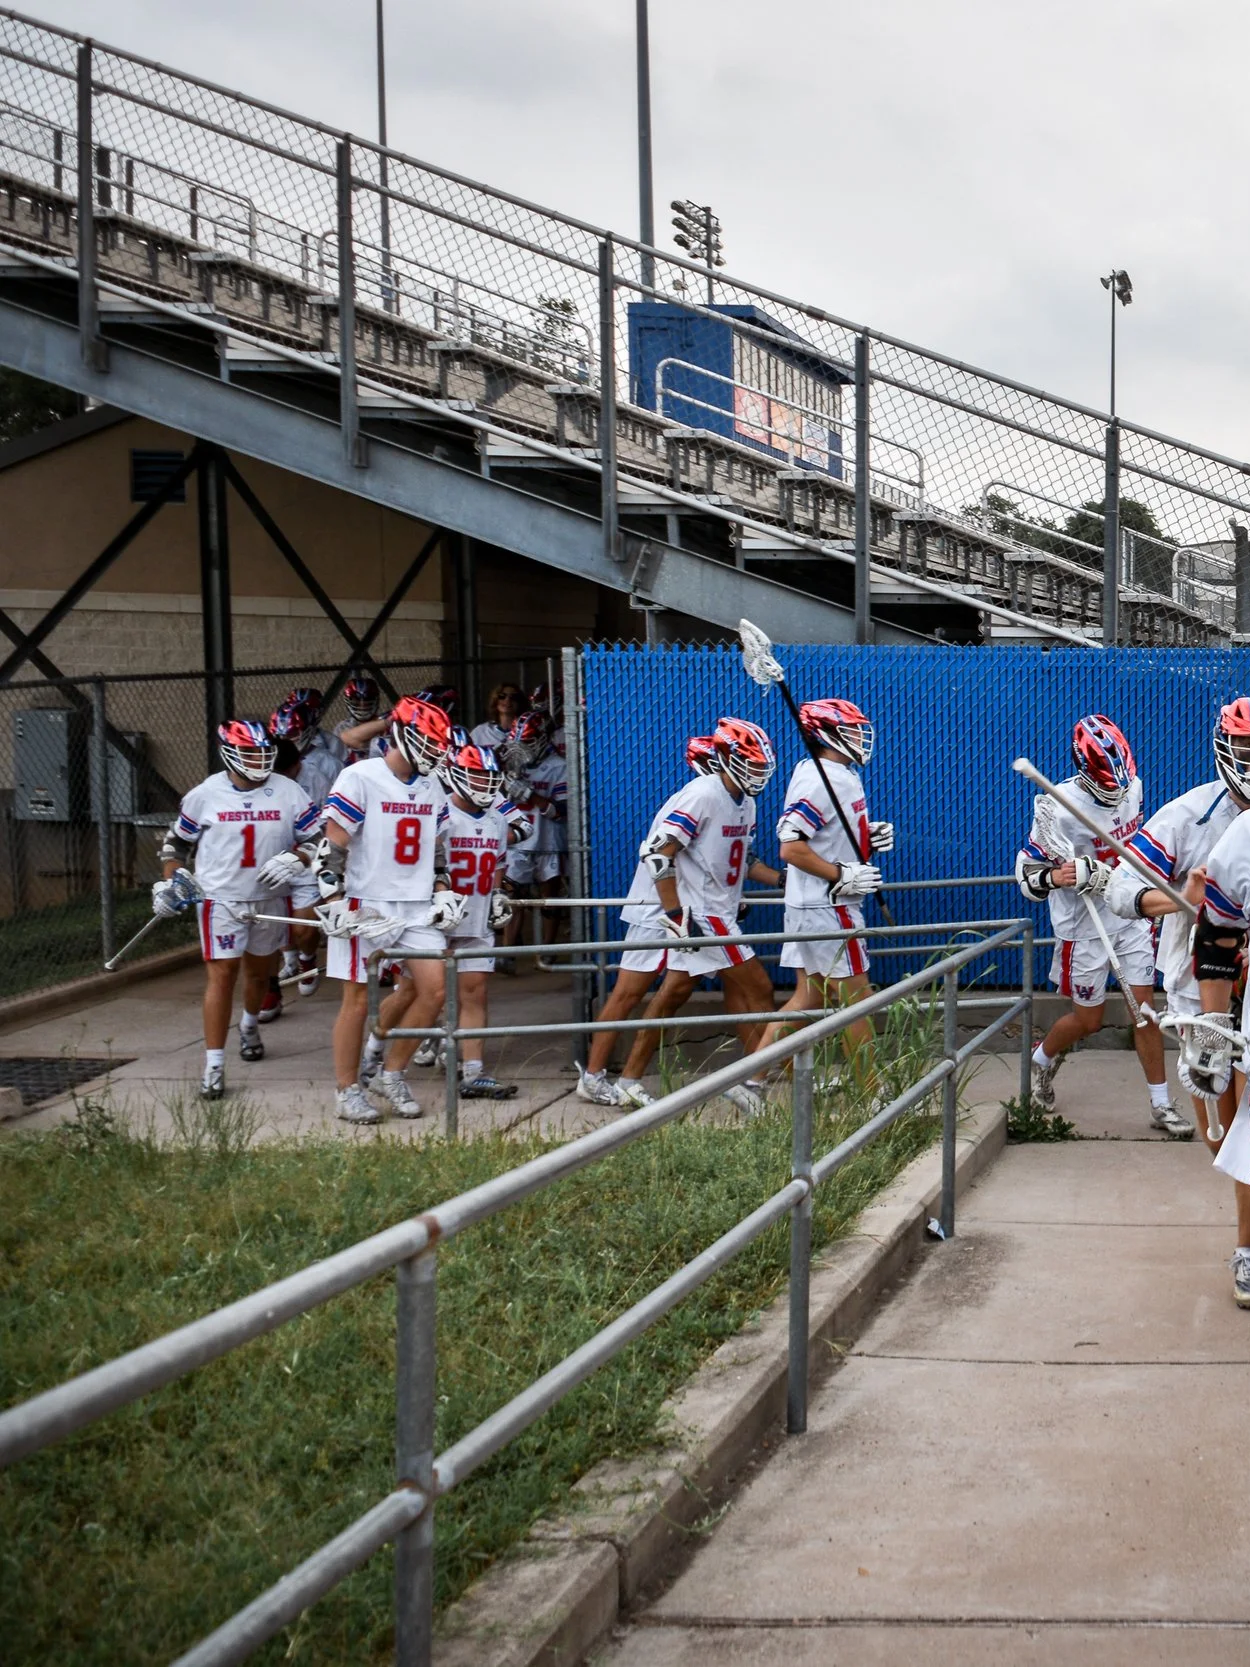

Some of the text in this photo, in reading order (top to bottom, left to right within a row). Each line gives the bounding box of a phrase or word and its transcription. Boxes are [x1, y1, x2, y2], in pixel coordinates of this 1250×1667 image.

[216, 810, 281, 822] WESTLAKE
[381, 802, 433, 815] WESTLAKE
[240, 824, 256, 868] 1
[394, 817, 422, 865] 8
[450, 836, 499, 849] WESTLAKE
[726, 839, 744, 887] 9
[450, 851, 497, 896] 28
[216, 934, 236, 950] W
[1075, 984, 1095, 1000] W
